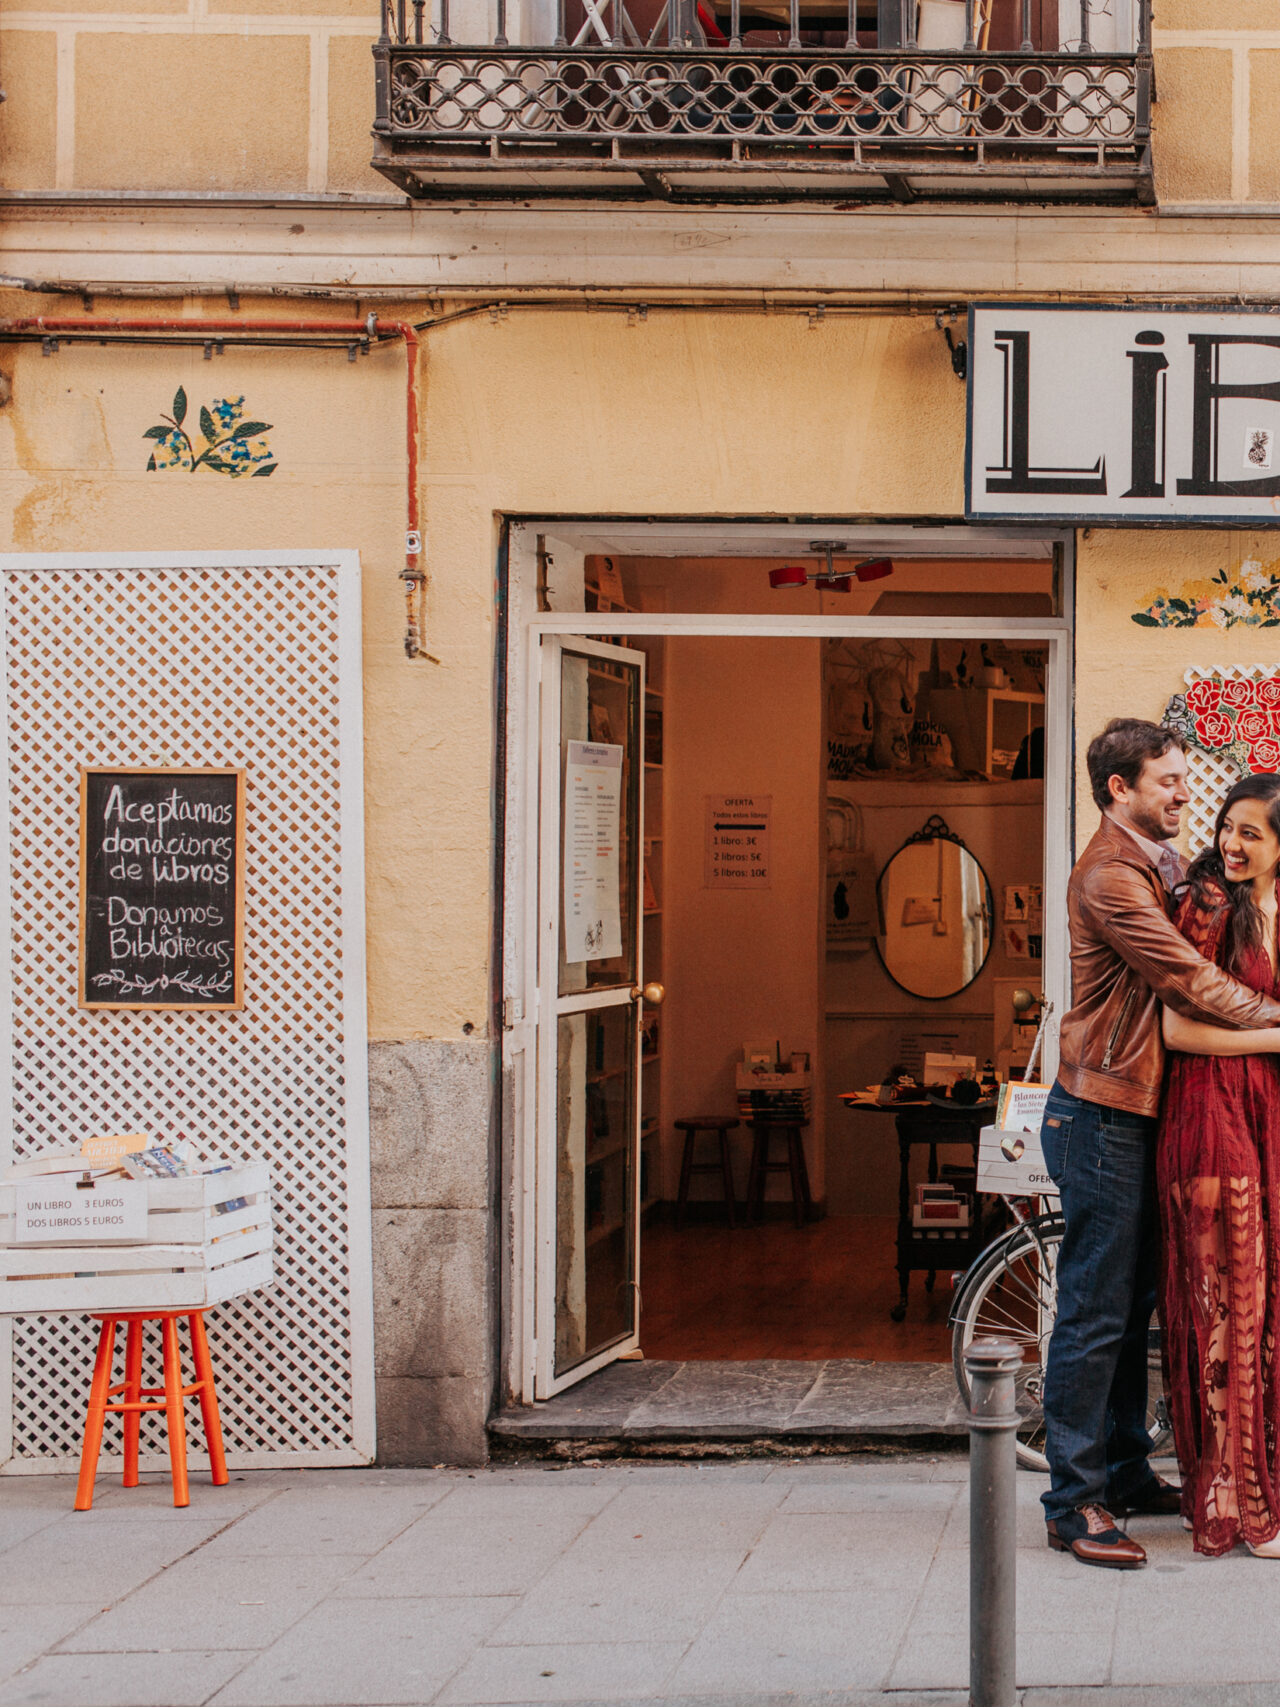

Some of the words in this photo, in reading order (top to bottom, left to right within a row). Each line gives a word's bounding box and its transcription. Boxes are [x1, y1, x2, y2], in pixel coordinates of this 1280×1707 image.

[104, 785, 233, 839] Aceptamos
[102, 827, 232, 861] donaciones
[713, 836, 718, 845] 1
[721, 836, 744, 845] libro:
[746, 836, 757, 845] 3€
[714, 852, 719, 861] 2
[721, 852, 748, 861] libros:
[750, 853, 762, 861] 5€
[110, 855, 143, 880] de
[152, 856, 230, 885] libros
[713, 869, 719, 877] 5
[721, 868, 748, 877] libros:
[751, 869, 767, 877] 10€
[1028, 1174, 1052, 1183] OFER
[27, 1202, 42, 1211] UN
[44, 1200, 72, 1210] LIBRO
[84, 1200, 90, 1208] 3
[93, 1199, 124, 1208] EUROS
[27, 1218, 47, 1228] DOS
[49, 1217, 82, 1227] LIBROS
[84, 1217, 90, 1225] 5
[93, 1216, 124, 1225] EUROS
